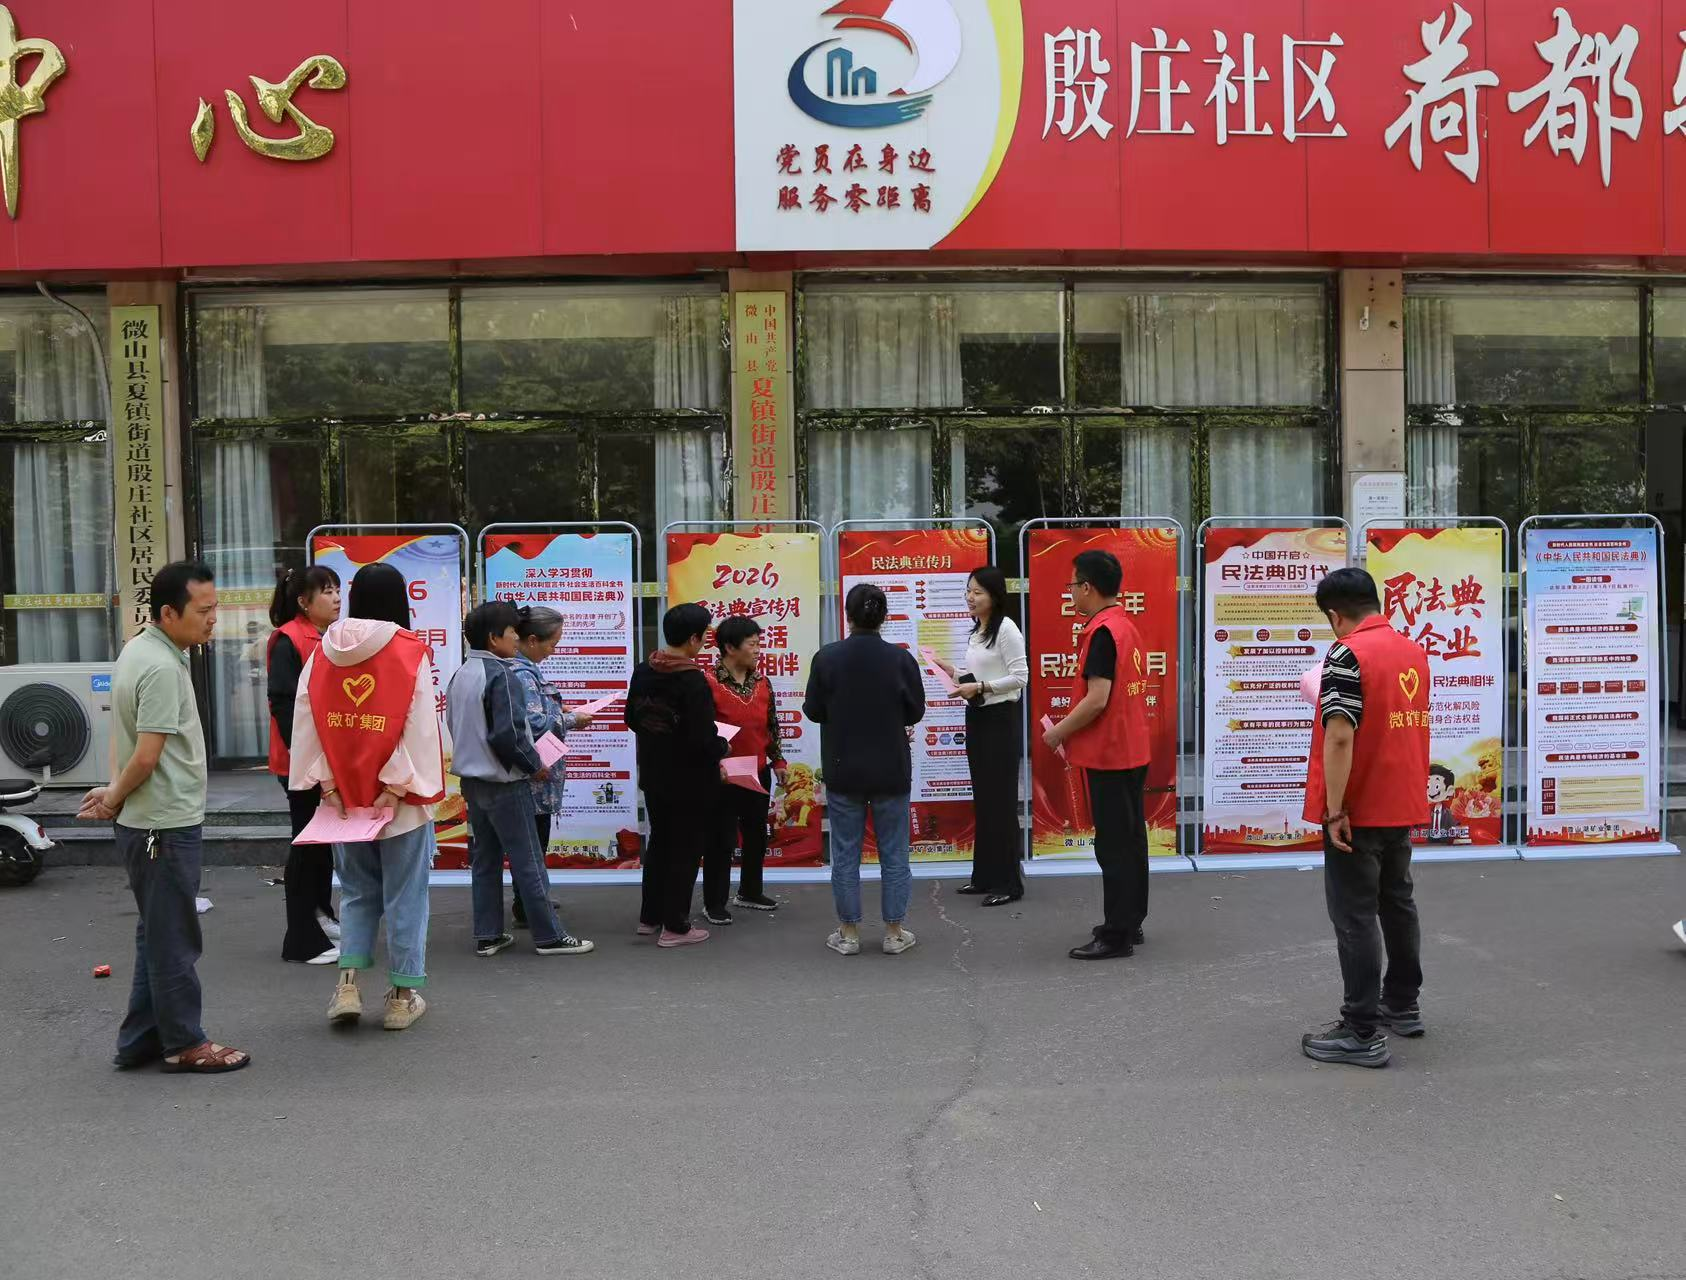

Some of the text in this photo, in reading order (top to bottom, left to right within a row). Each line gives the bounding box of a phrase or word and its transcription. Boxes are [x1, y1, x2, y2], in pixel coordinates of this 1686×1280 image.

[1040, 2, 1686, 187] 殷庄社区 荷都
[776, 144, 936, 174] 党员在身边
[777, 183, 932, 213] 服务零距离
[745, 304, 758, 372] 微山县
[765, 304, 778, 372] 中国共产党
[121, 319, 155, 637] 微山县夏镇街道殷庄社区居民委员
[871, 555, 952, 570] 民法典宣传月
[1252, 550, 1300, 560] 中国开启
[1536, 551, 1647, 562] 《中华人民共和国民法典》
[525, 568, 593, 579] 深入学习贯彻
[712, 562, 779, 590] 2026
[1221, 564, 1329, 581] 民法典时代
[567, 580, 623, 588] 社会生活百科全书
[14, 595, 104, 606] 殷庄社区党群服务中
[495, 591, 625, 602] 《中华人民共和国民法典》
[1383, 571, 1486, 626] 民法典
[1397, 622, 1481, 661] 企业
[1433, 675, 1495, 688] 民法典相伴
[327, 711, 386, 732] 微矿集团
